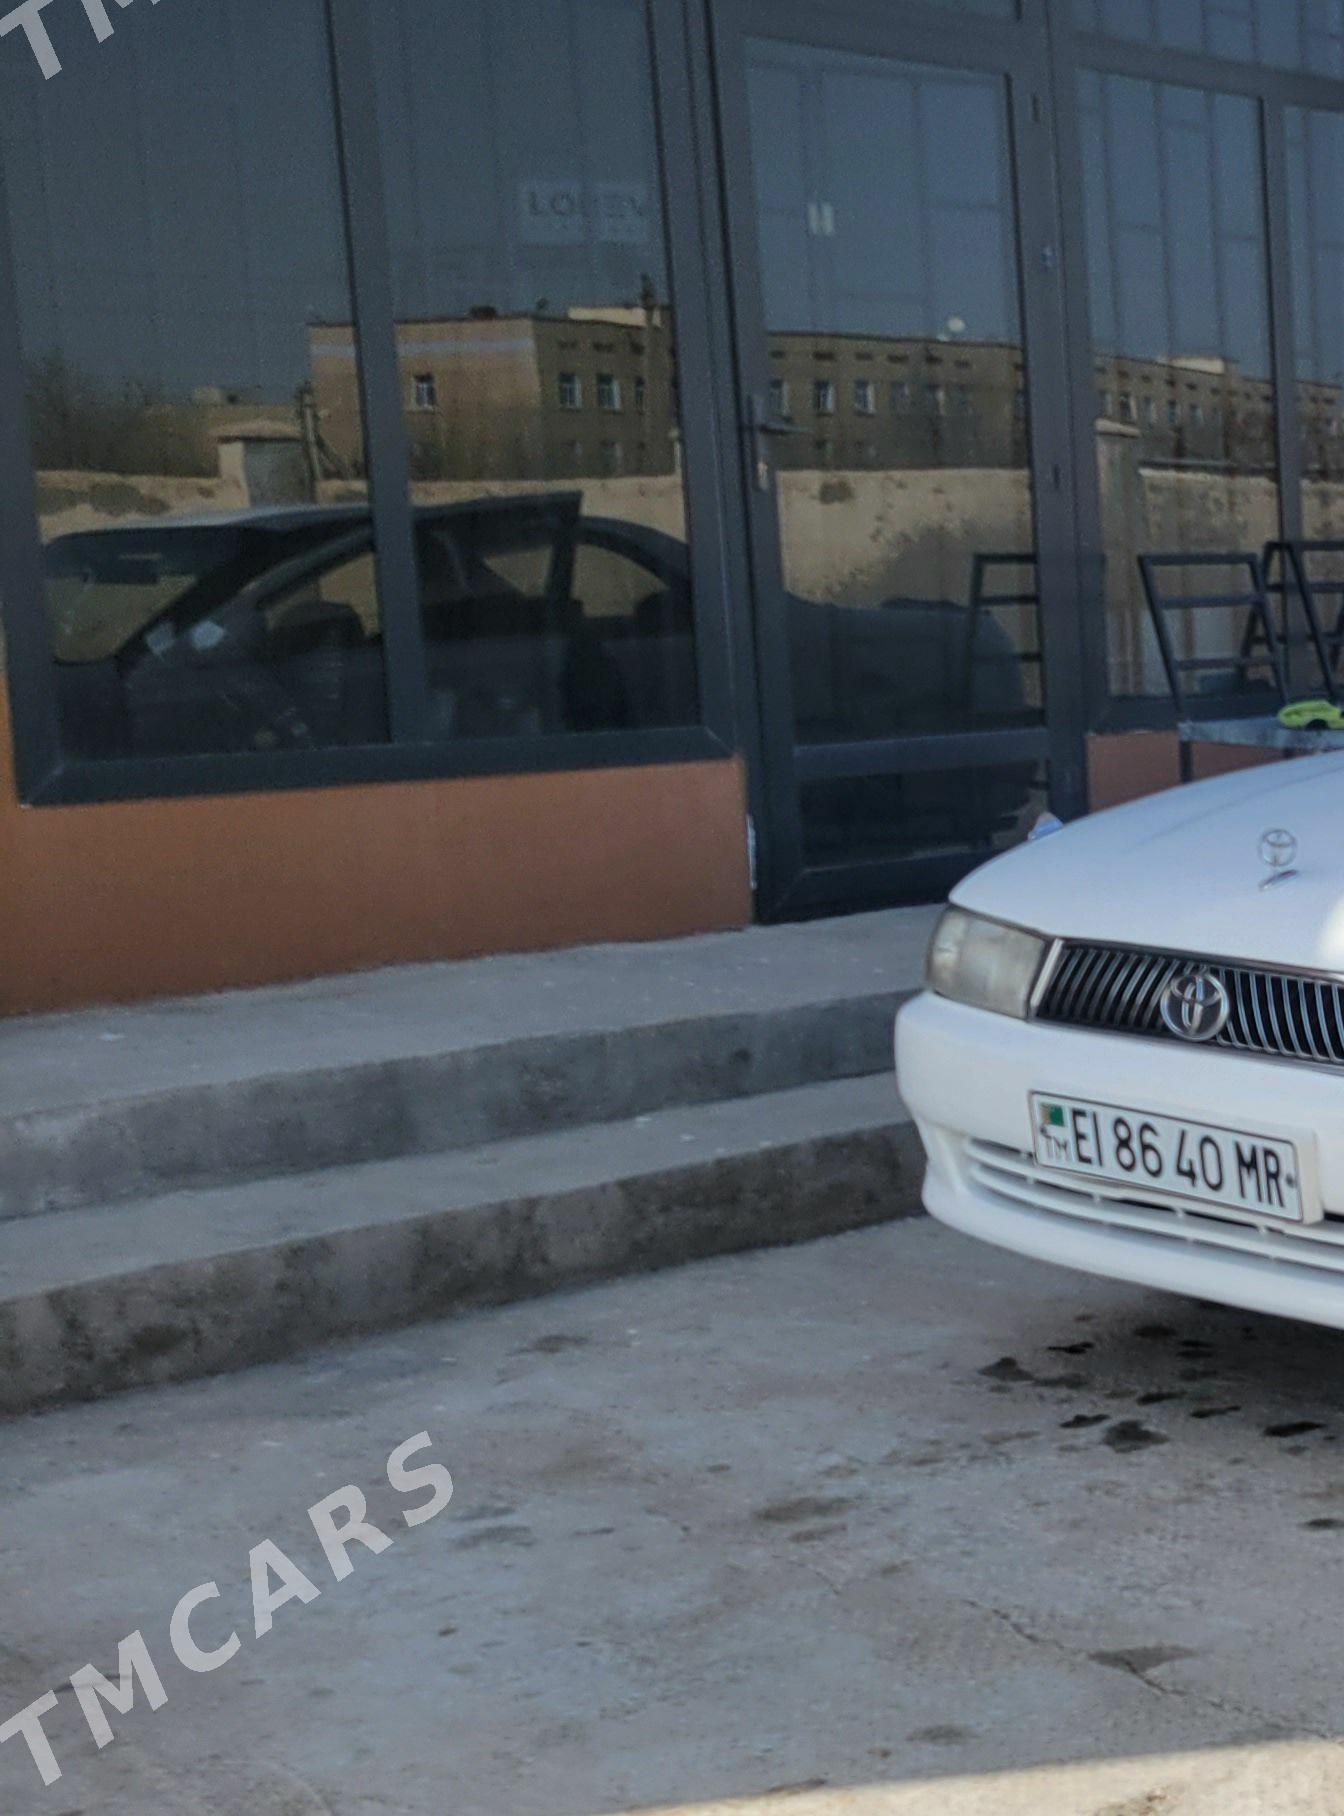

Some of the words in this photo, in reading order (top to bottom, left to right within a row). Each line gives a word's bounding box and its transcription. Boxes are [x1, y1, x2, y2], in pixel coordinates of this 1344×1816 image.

[1071, 1107, 1104, 1168] EI
[1113, 1116, 1163, 1178] 86
[1175, 1128, 1225, 1192] 40
[1234, 1140, 1285, 1208] MR
